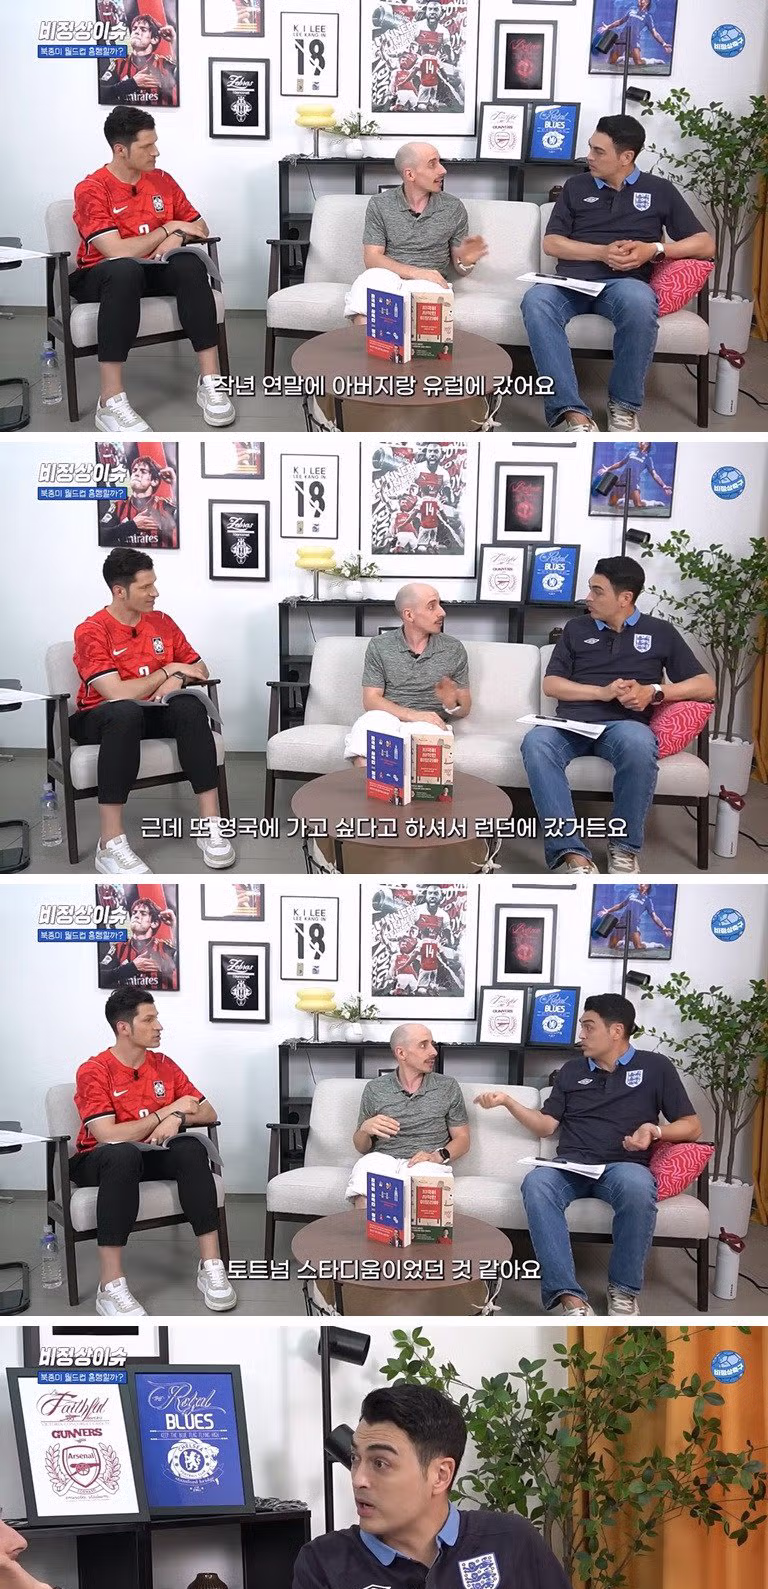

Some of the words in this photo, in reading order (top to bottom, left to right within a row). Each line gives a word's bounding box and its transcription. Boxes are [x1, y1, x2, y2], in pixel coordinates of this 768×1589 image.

[310, 25, 326, 33] LEE
[425, 60, 435, 74] 14
[544, 121, 566, 129] BLUES
[165, 1413, 215, 1430] BLUES
[52, 1428, 103, 1438] GUNNERS
